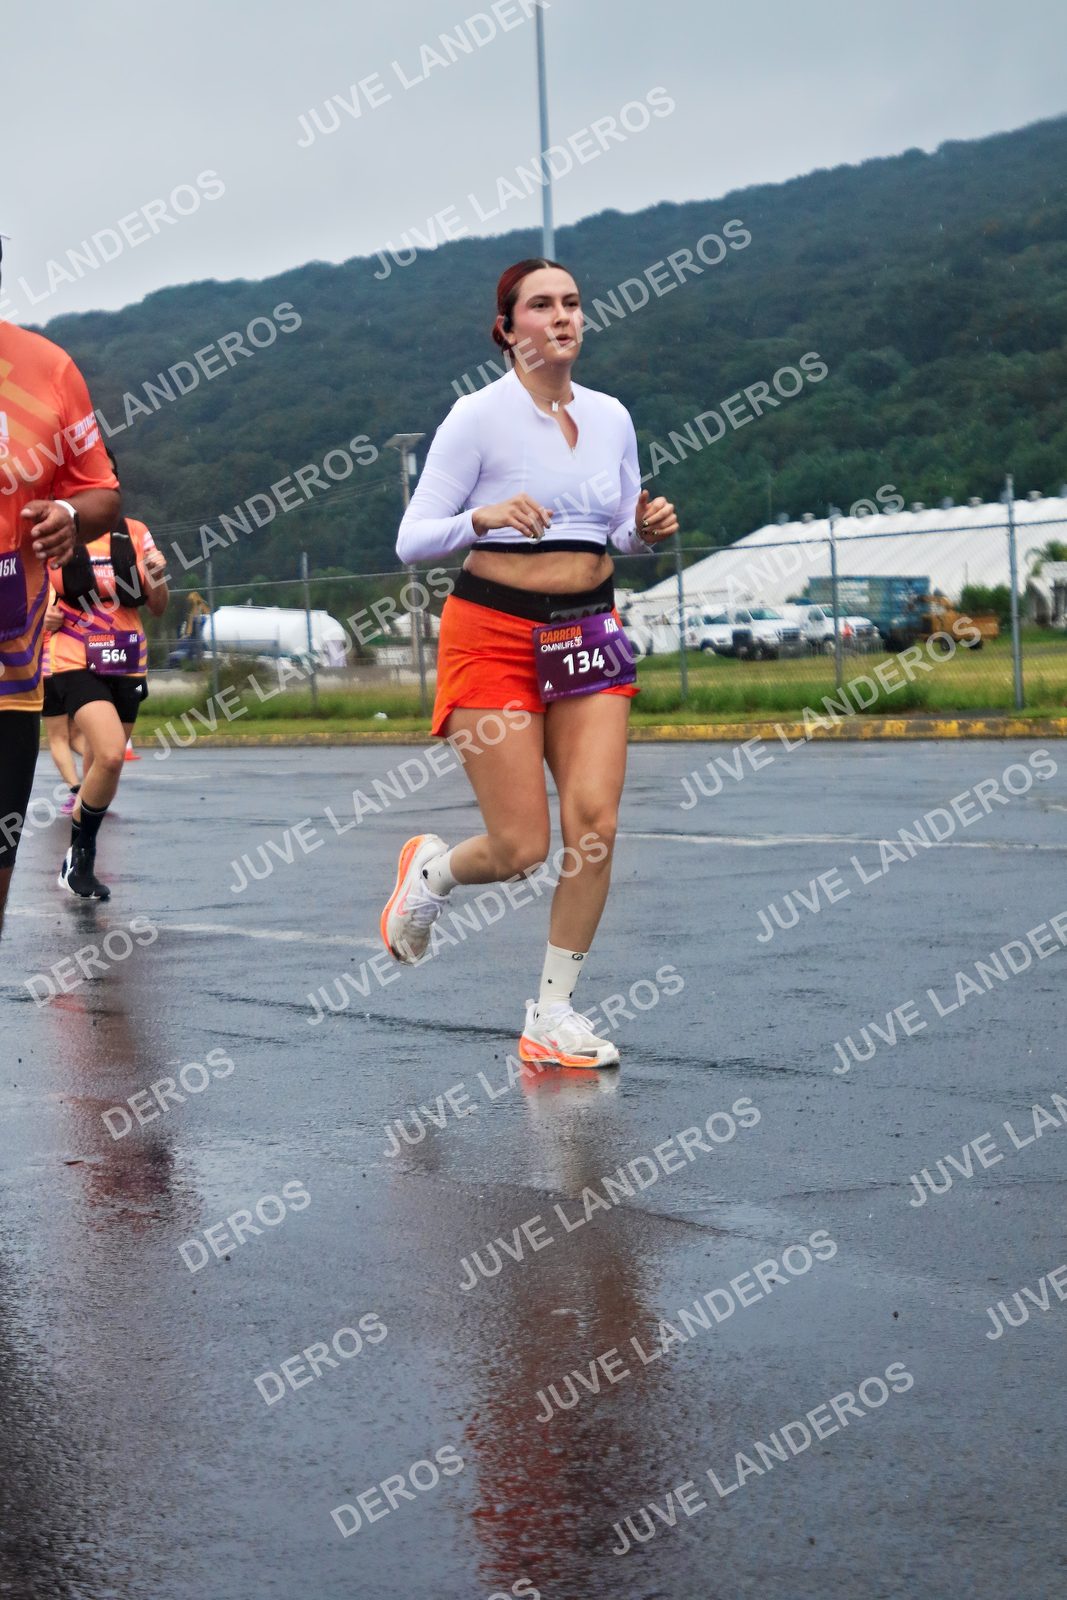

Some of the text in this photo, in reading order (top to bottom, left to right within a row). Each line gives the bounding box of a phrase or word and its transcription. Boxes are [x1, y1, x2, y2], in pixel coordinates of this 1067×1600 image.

[540, 626, 582, 643] CARRERA
[541, 640, 574, 652] OMNILIFE
[101, 648, 127, 664] 564
[563, 648, 605, 675] 134
